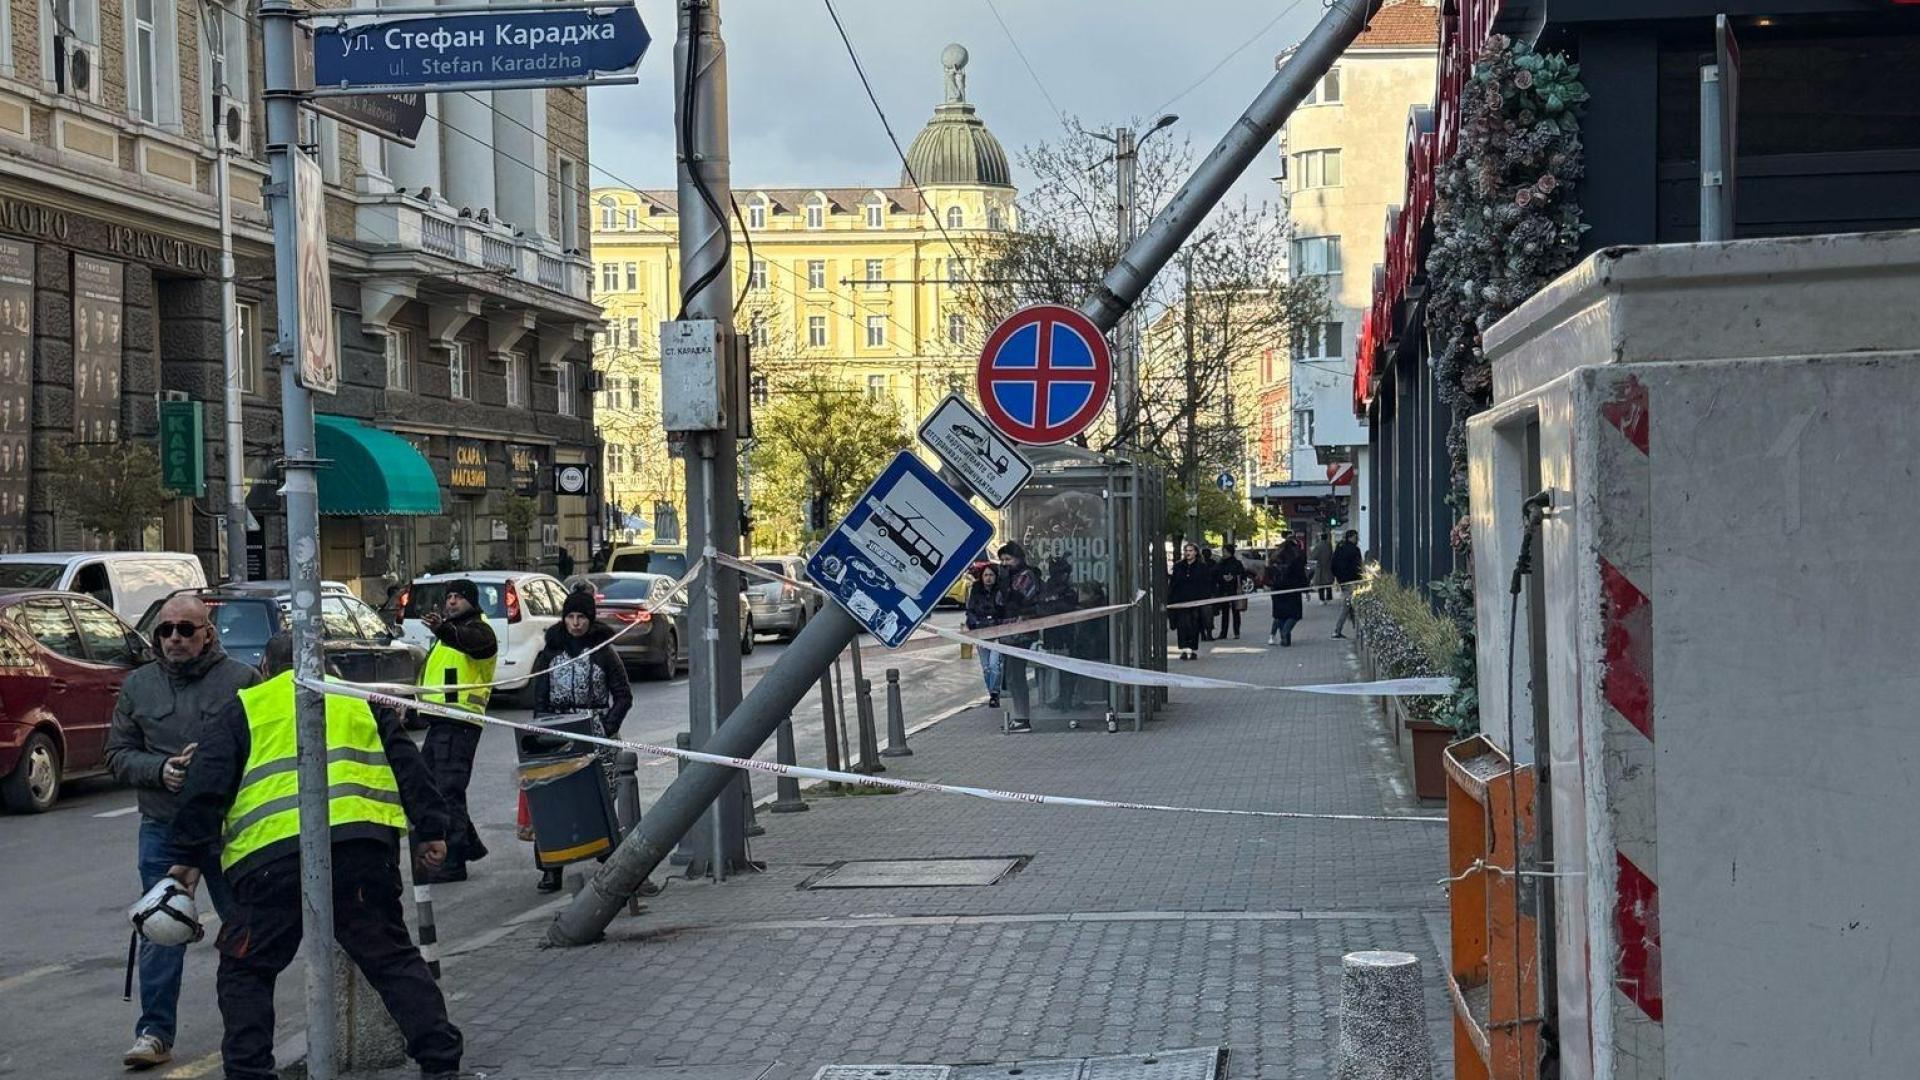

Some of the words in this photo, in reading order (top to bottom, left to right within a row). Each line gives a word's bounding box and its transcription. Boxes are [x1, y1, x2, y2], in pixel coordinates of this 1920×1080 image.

[341, 33, 375, 57] ул.
[384, 27, 485, 53] Стефан
[496, 21, 615, 47] Караджа
[389, 60, 409, 76] ul.
[422, 56, 483, 76] Stefan
[491, 52, 582, 72] Karadzha
[107, 223, 210, 274] ИЗКУСТВО
[665, 347, 676, 356] СТ.
[678, 346, 712, 356] КАРАДЖА
[168, 416, 187, 482] КАСА
[457, 446, 482, 465] СКАРА
[451, 468, 486, 488] МАГАЗИН
